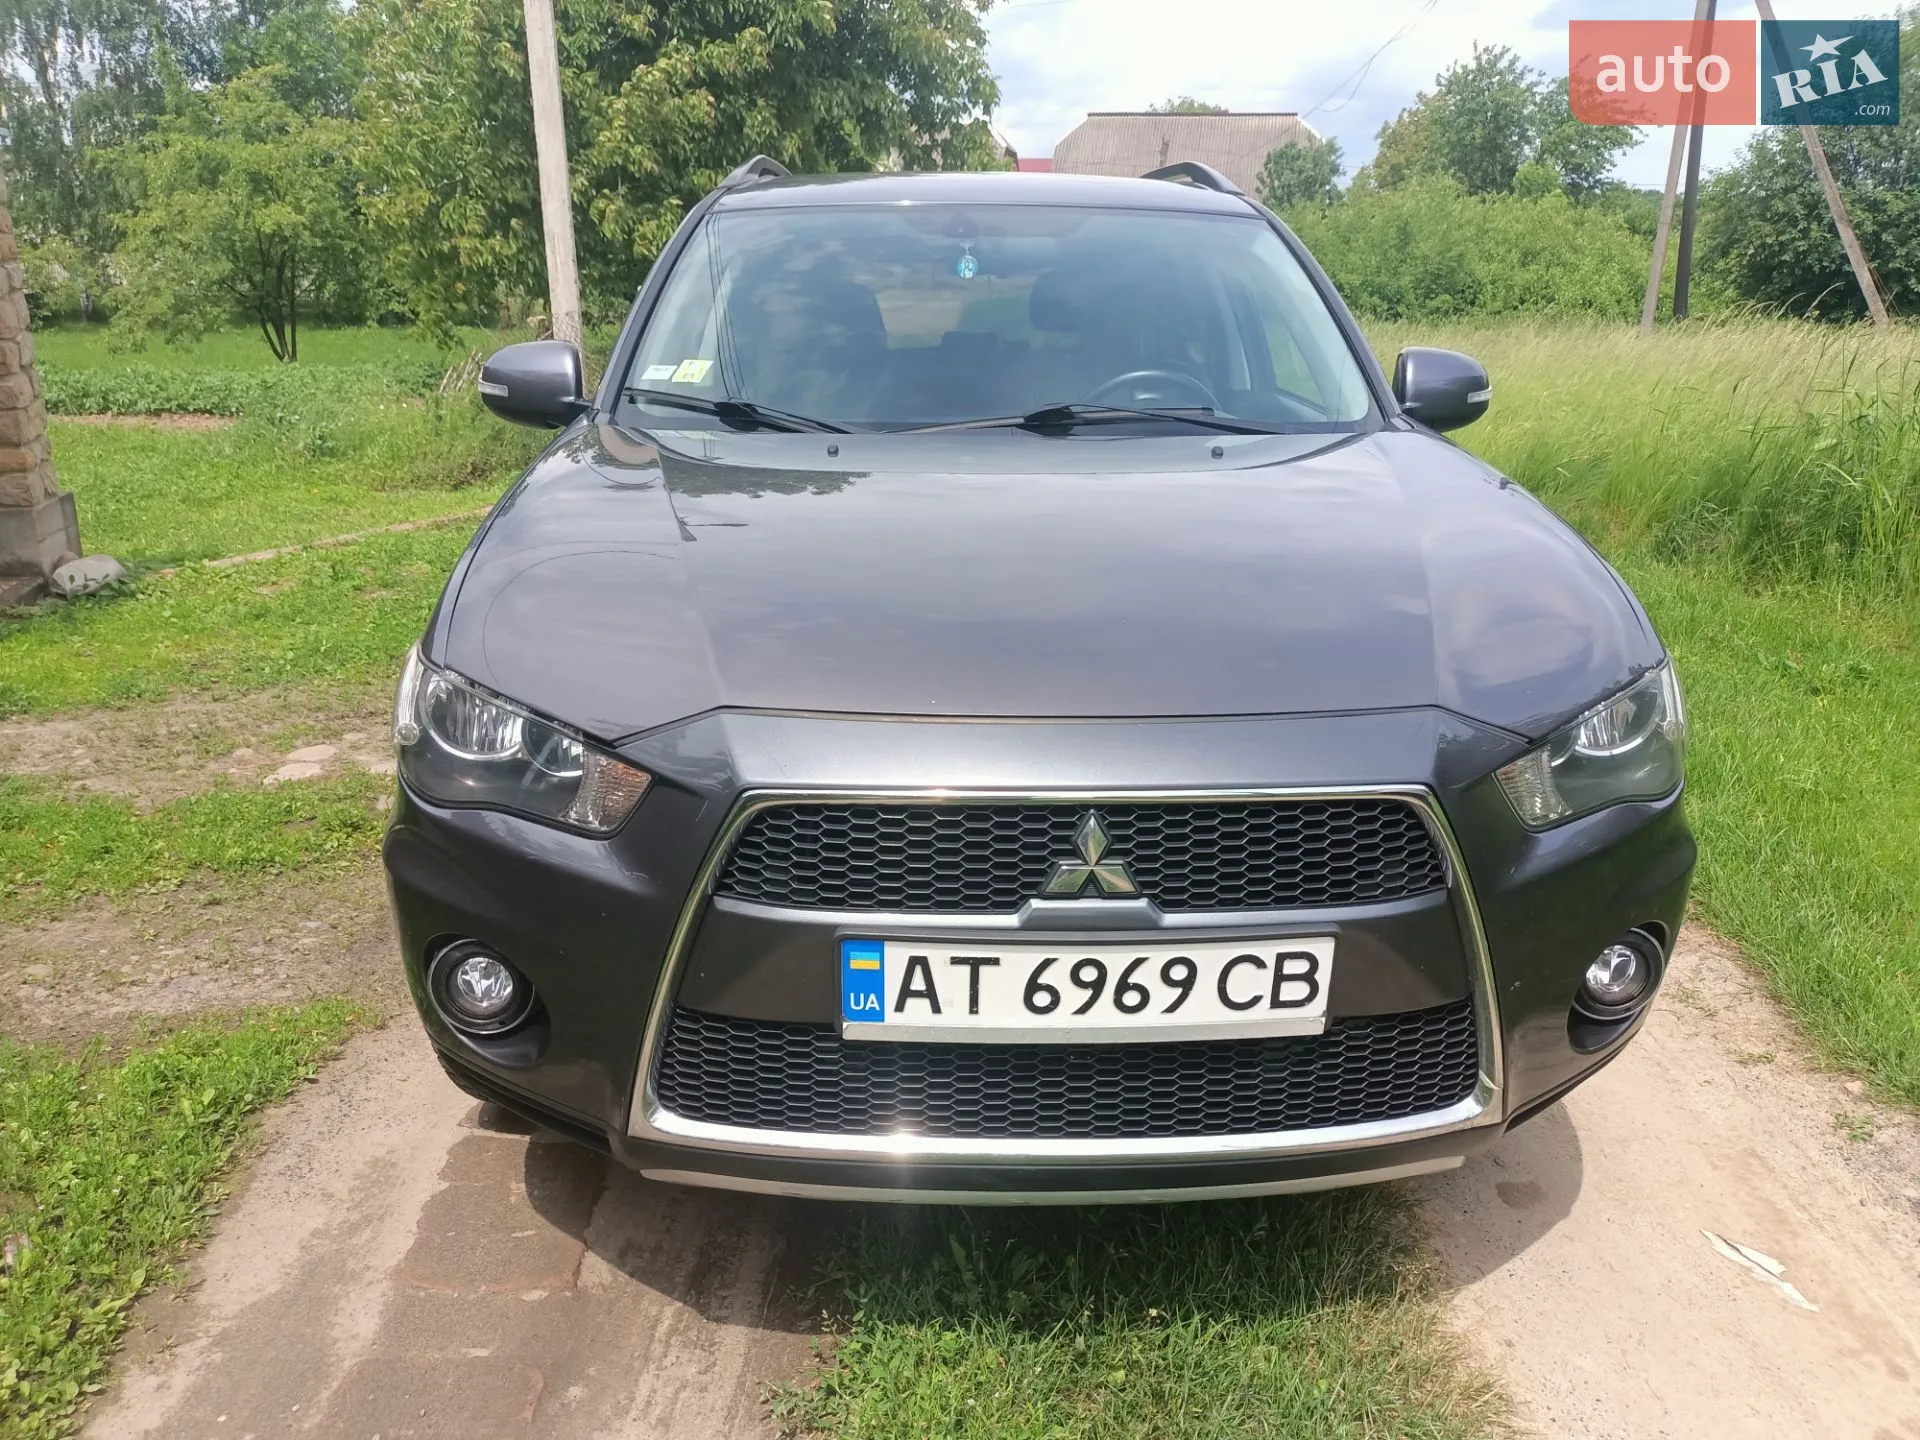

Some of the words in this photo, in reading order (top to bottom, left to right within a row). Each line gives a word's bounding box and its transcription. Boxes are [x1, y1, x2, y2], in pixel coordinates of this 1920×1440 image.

[850, 992, 880, 1011] UA
[893, 955, 1001, 1015] AT
[1022, 955, 1198, 1015] 6969
[1217, 951, 1320, 1012] CB
